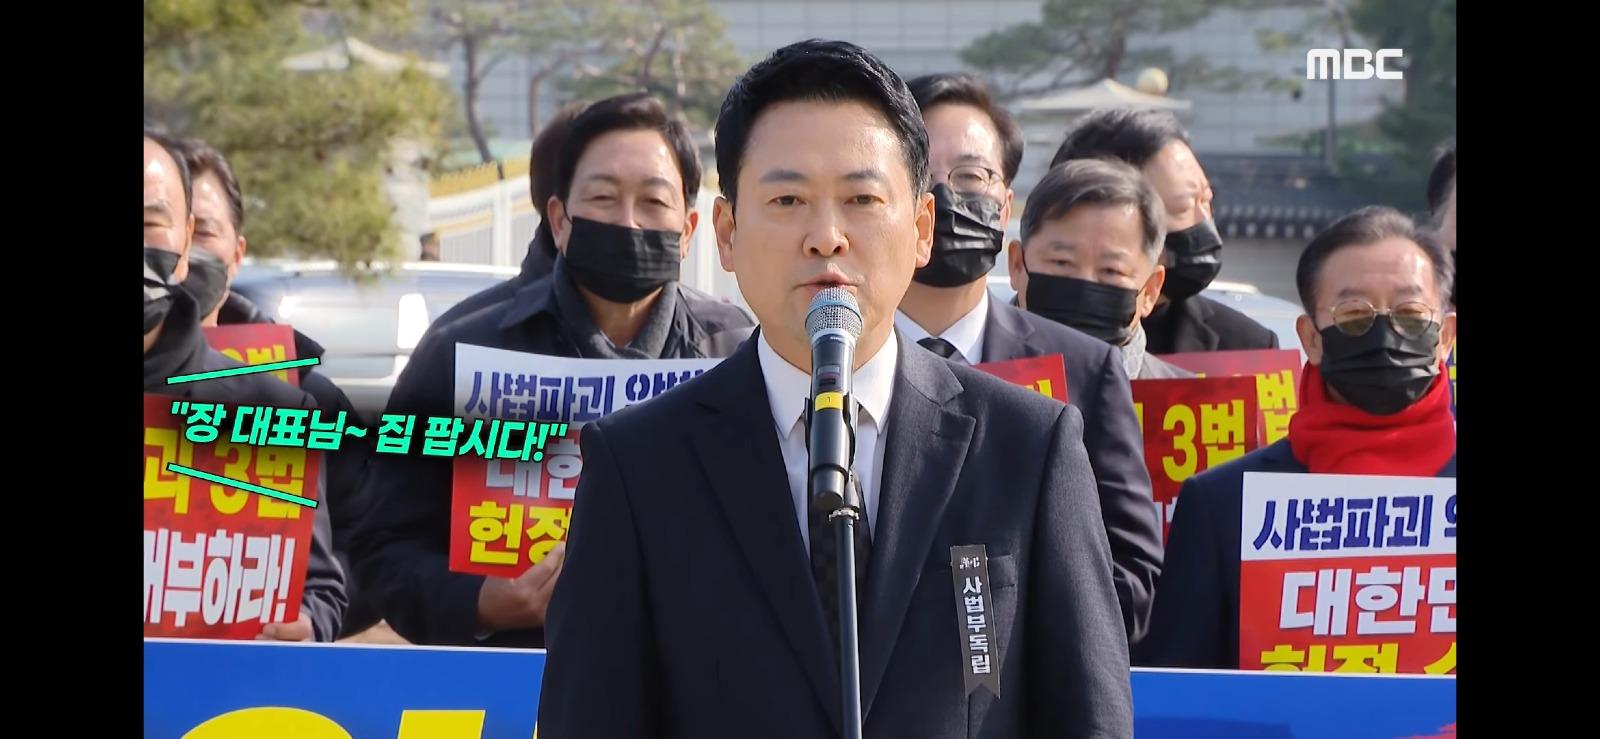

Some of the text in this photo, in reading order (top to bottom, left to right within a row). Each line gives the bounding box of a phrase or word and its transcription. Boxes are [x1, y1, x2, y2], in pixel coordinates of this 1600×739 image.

[464, 371, 616, 422] 사법파괴
[1162, 400, 1245, 482] 3법
[1253, 495, 1434, 551] 사법파괴
[963, 576, 991, 674] 사법부독립
